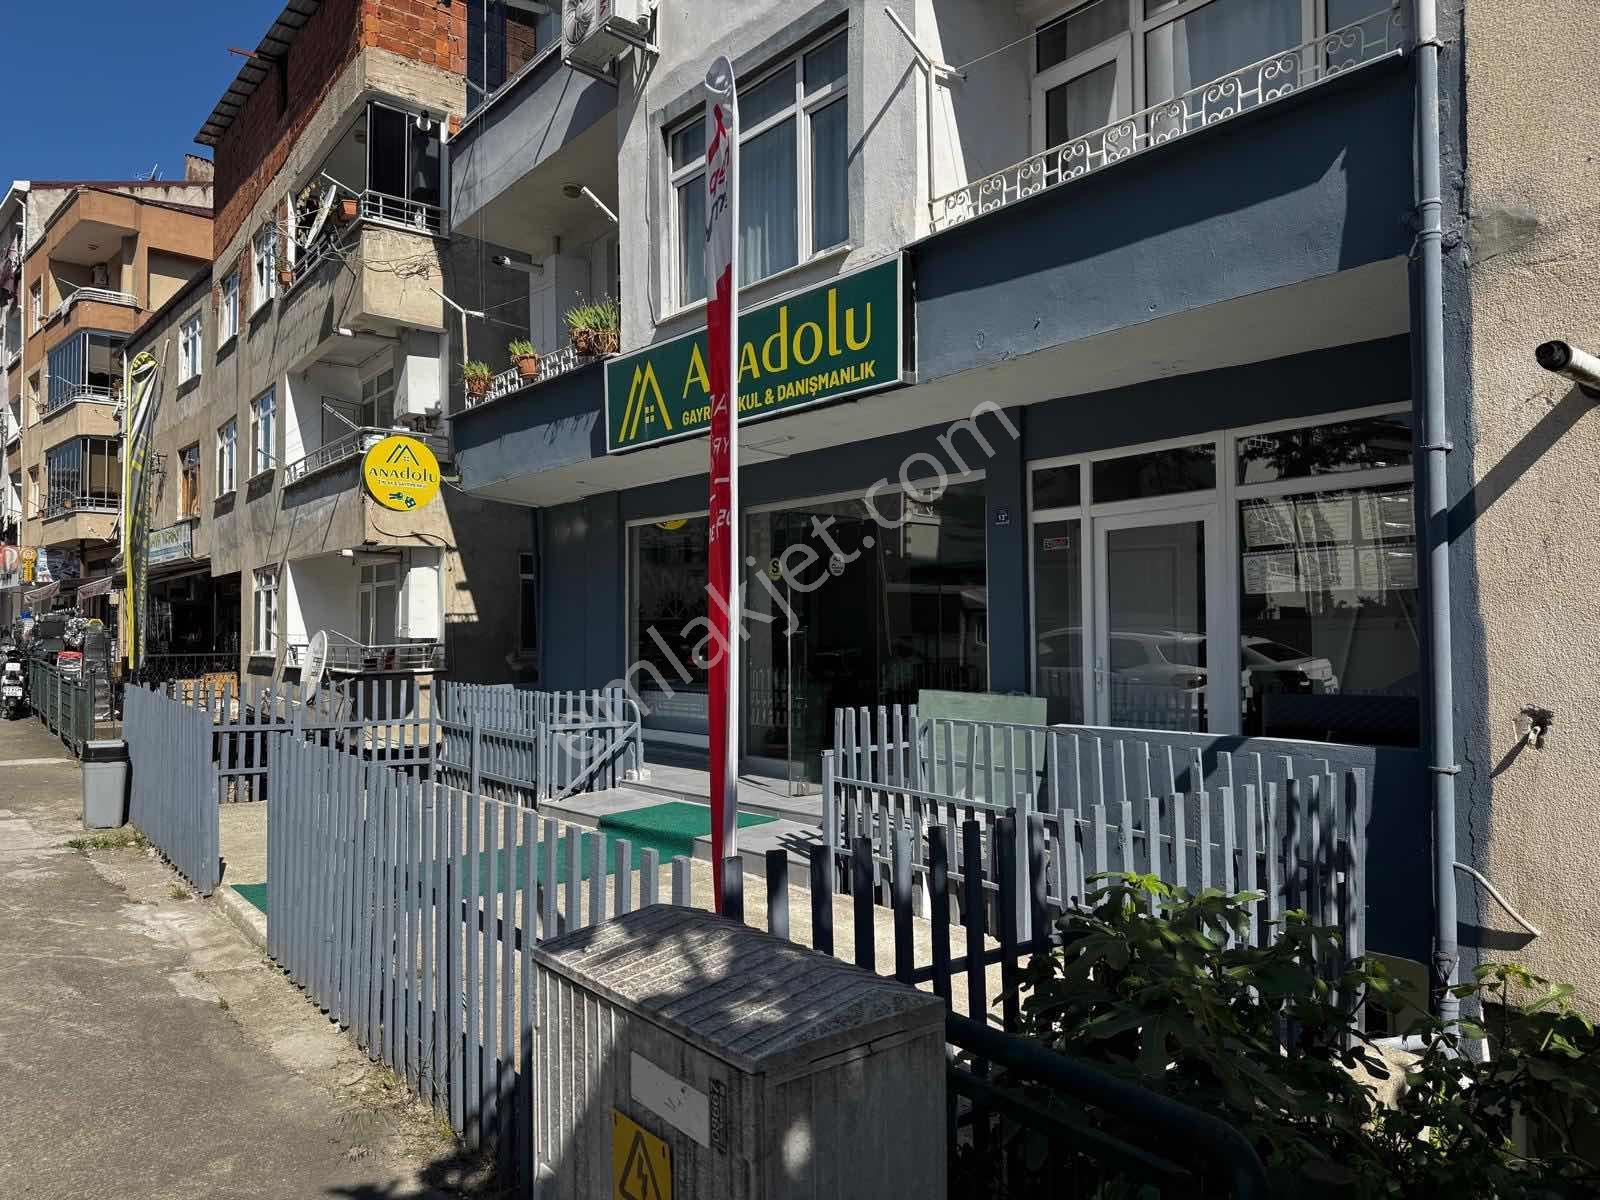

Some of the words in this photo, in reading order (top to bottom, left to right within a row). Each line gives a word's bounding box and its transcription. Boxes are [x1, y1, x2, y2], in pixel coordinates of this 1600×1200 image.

[683, 392, 762, 426] GAYRKUL
[764, 387, 775, 405] &
[777, 360, 876, 402] DANIŞMANLIK
